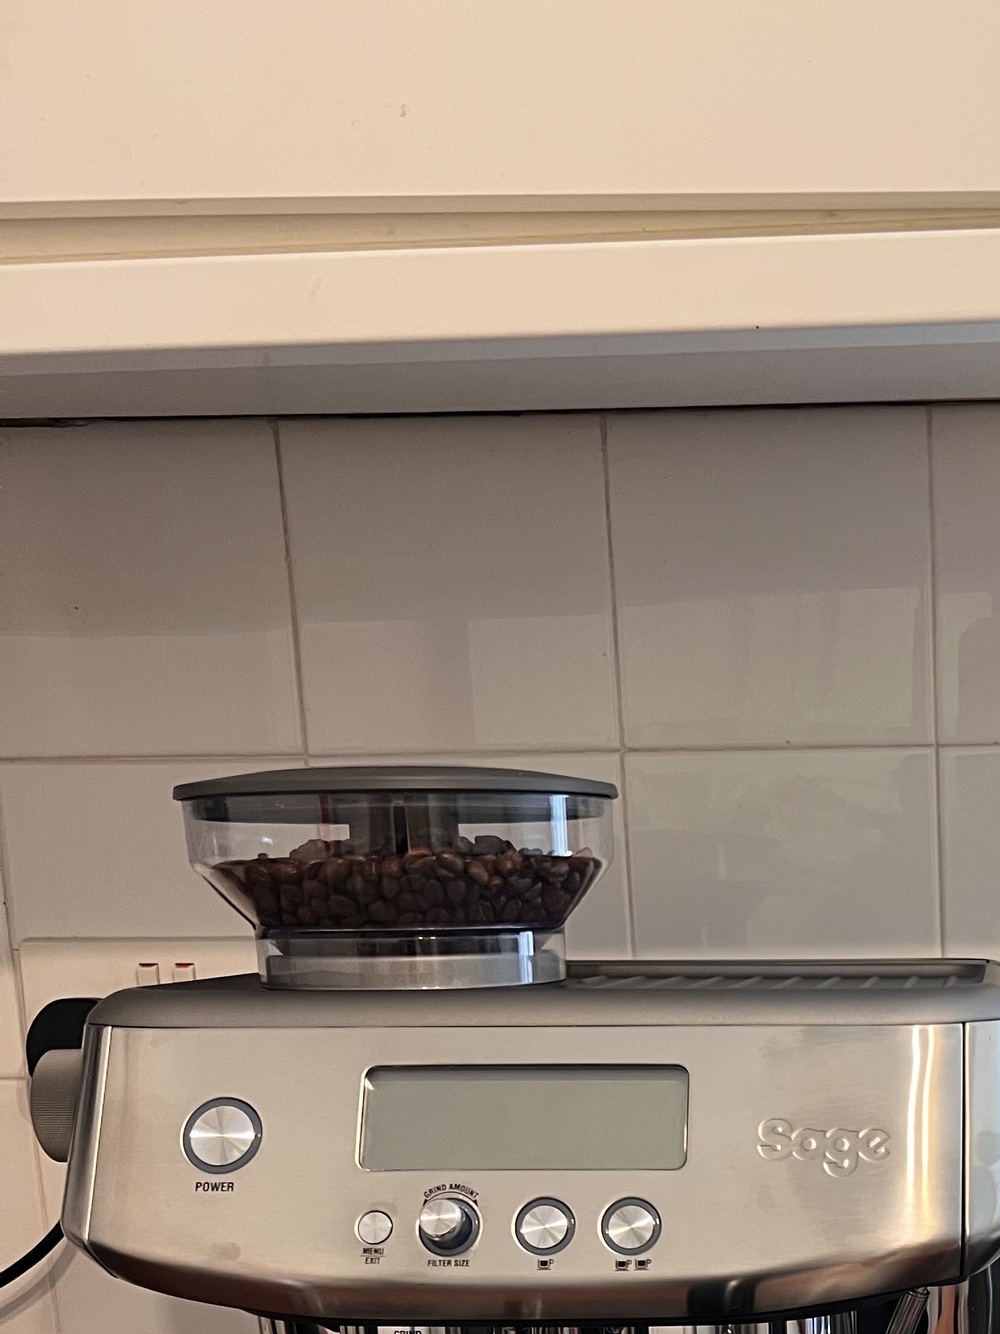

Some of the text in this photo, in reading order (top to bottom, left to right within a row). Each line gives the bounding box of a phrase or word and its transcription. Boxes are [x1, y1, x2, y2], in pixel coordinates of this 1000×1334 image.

[757, 1117, 891, 1178] Sage
[195, 1181, 235, 1192] POWER
[423, 1183, 479, 1199] GRIND AMOUNT
[362, 1247, 385, 1255] MENU
[427, 1259, 470, 1267] FILTER SIZE
